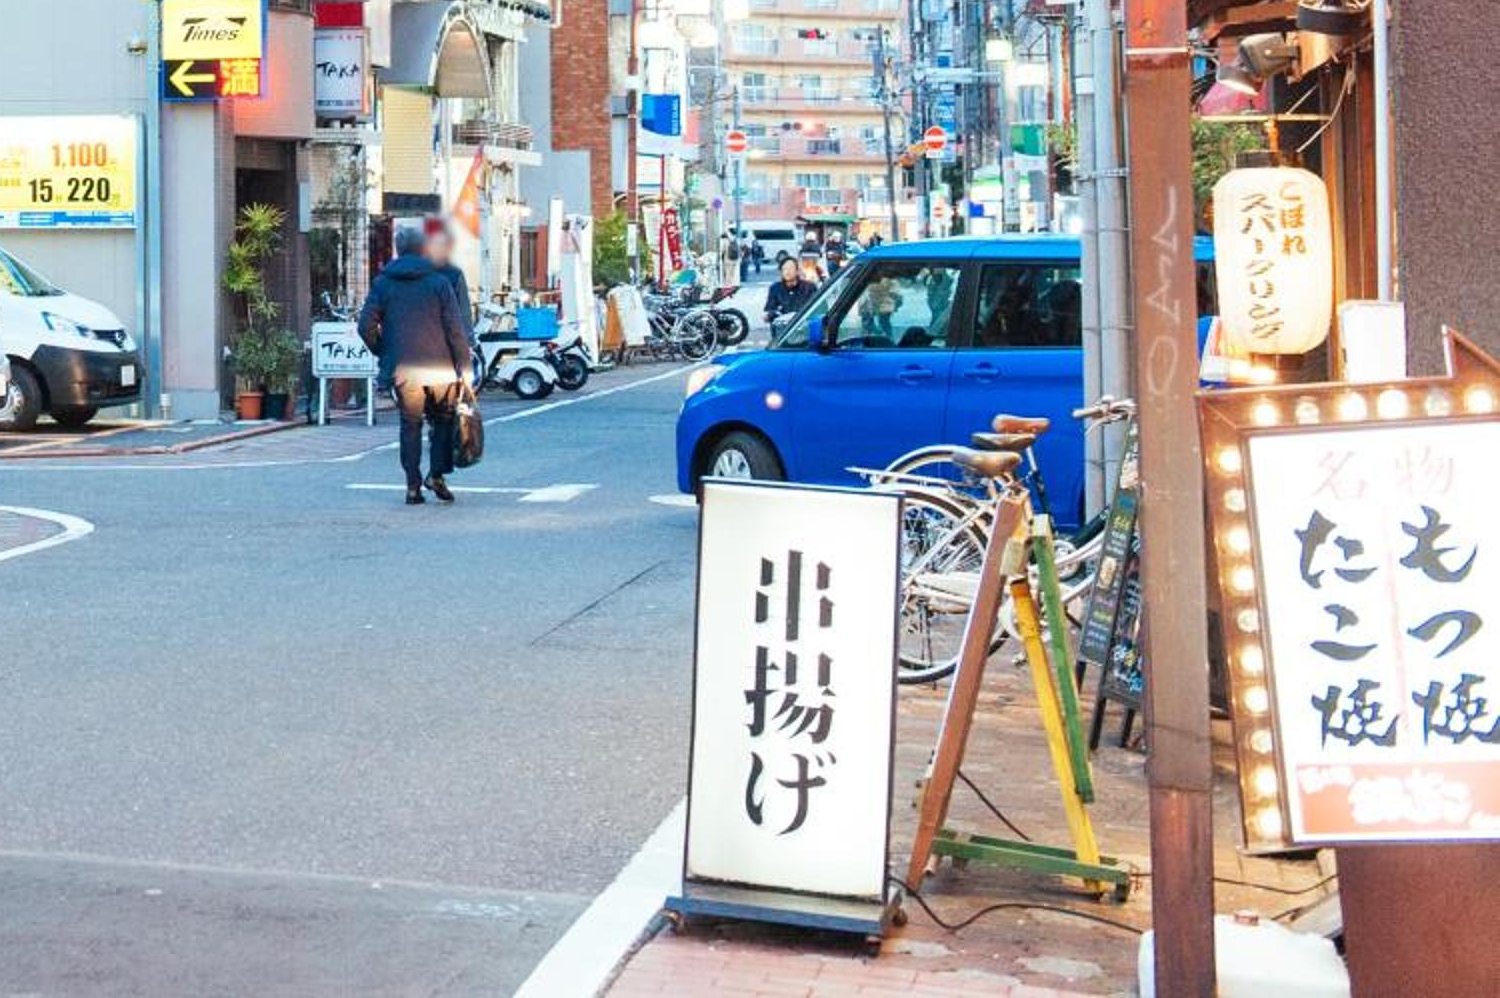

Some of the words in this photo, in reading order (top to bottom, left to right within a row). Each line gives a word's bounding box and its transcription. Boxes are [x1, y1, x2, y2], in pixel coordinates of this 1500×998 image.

[182, 17, 243, 43] Times
[219, 58, 259, 95] 満
[315, 61, 360, 78] TAKA
[52, 143, 107, 168] 1,100
[28, 178, 53, 203] 15
[67, 177, 110, 202] 220
[321, 341, 369, 359] TAKA
[1311, 445, 1456, 502] 名物
[1293, 508, 1401, 752] たこ焼
[743, 548, 837, 837] 串揚げ
